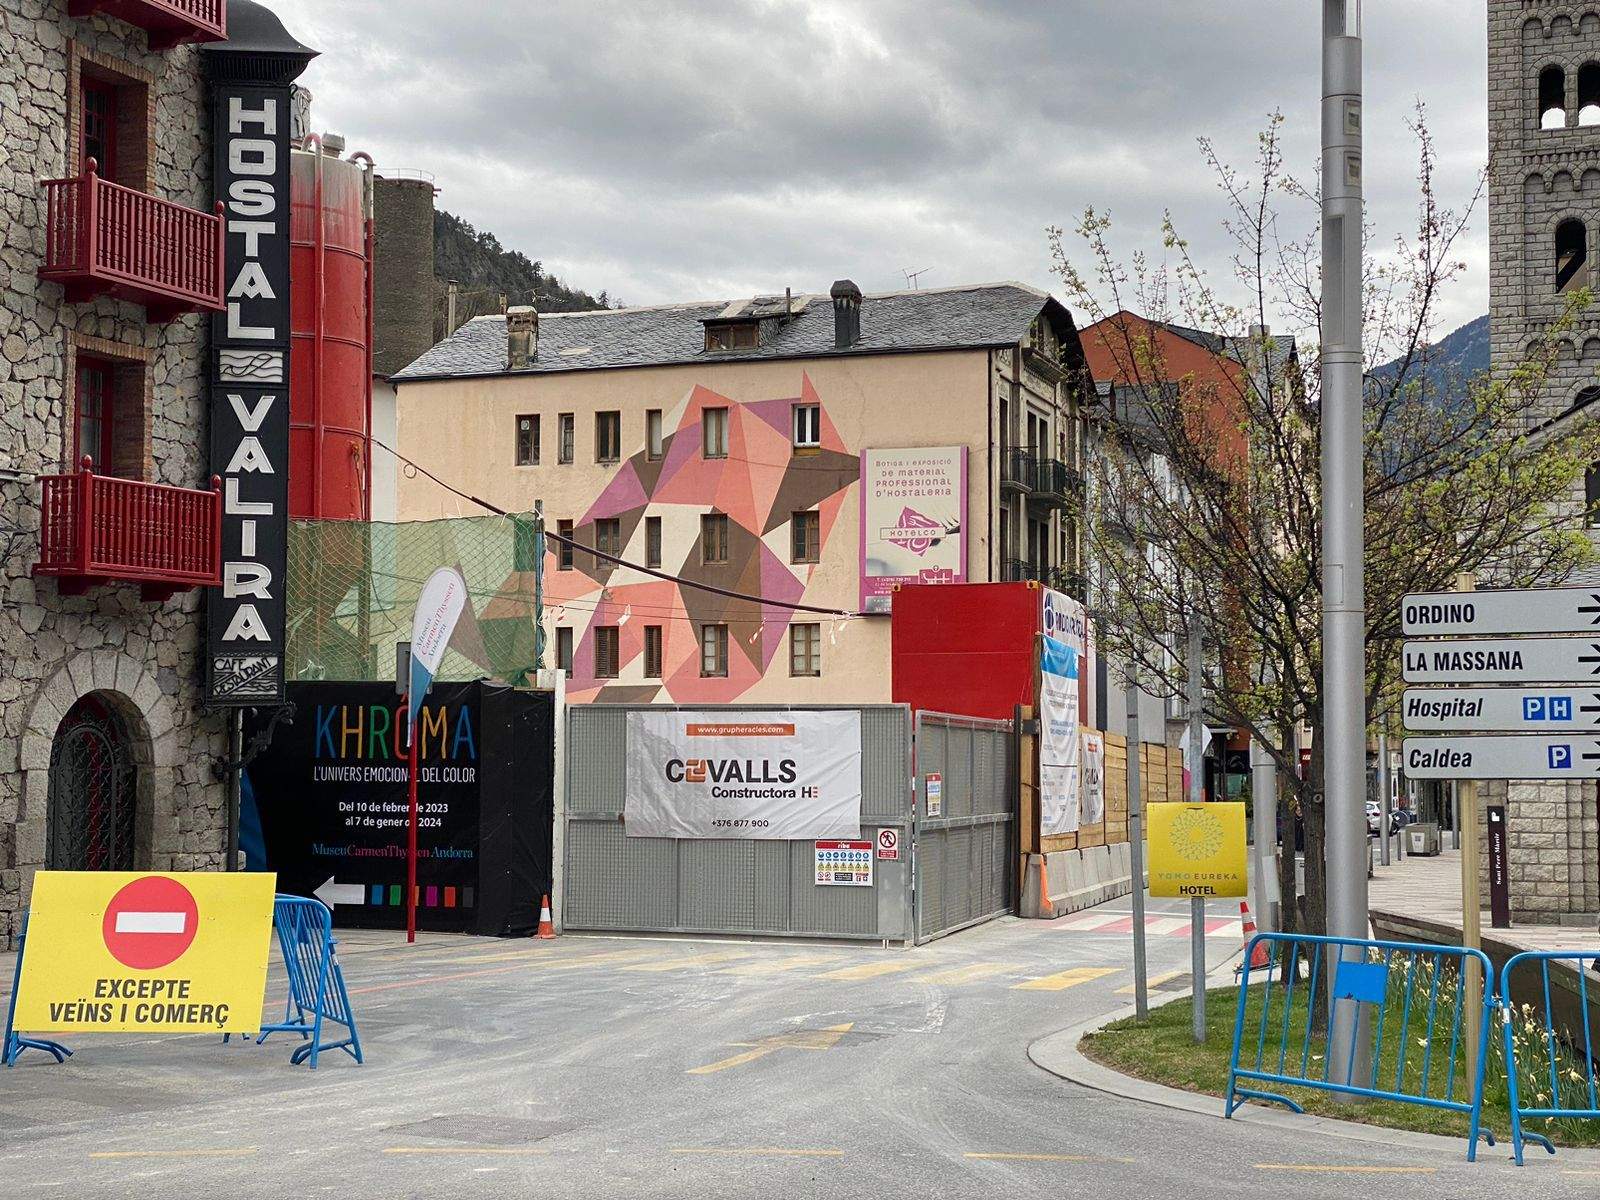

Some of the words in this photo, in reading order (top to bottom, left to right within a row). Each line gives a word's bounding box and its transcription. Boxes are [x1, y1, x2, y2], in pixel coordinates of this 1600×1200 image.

[227, 97, 277, 340] HOSTAL
[221, 394, 277, 642] VALIRA
[1406, 604, 1475, 625] ORDINO
[1406, 653, 1428, 671] LA
[1434, 651, 1523, 671] MASSANA
[1407, 698, 1483, 721] Hospital
[1409, 749, 1472, 768] Caldea
[313, 766, 362, 782] L'UNIVERS
[422, 767, 441, 783] DEL
[443, 767, 476, 783] COLOR
[712, 787, 796, 798] Constructora
[338, 801, 354, 812] Del
[357, 802, 367, 812] 10
[369, 802, 381, 812] de
[426, 803, 448, 813] 2023
[345, 816, 354, 826] al
[355, 817, 361, 826] 7
[363, 816, 375, 826] de
[376, 819, 403, 828] gener
[418, 817, 442, 827] 2024
[712, 819, 731, 827] +376
[734, 819, 749, 827] 877
[752, 819, 769, 827] 900
[1180, 885, 1216, 894] HOTEL
[95, 979, 191, 999] EXCEPTE
[50, 998, 113, 1023] VEÏNS
[120, 1004, 127, 1022] I
[135, 1003, 229, 1029] COMERÇ
